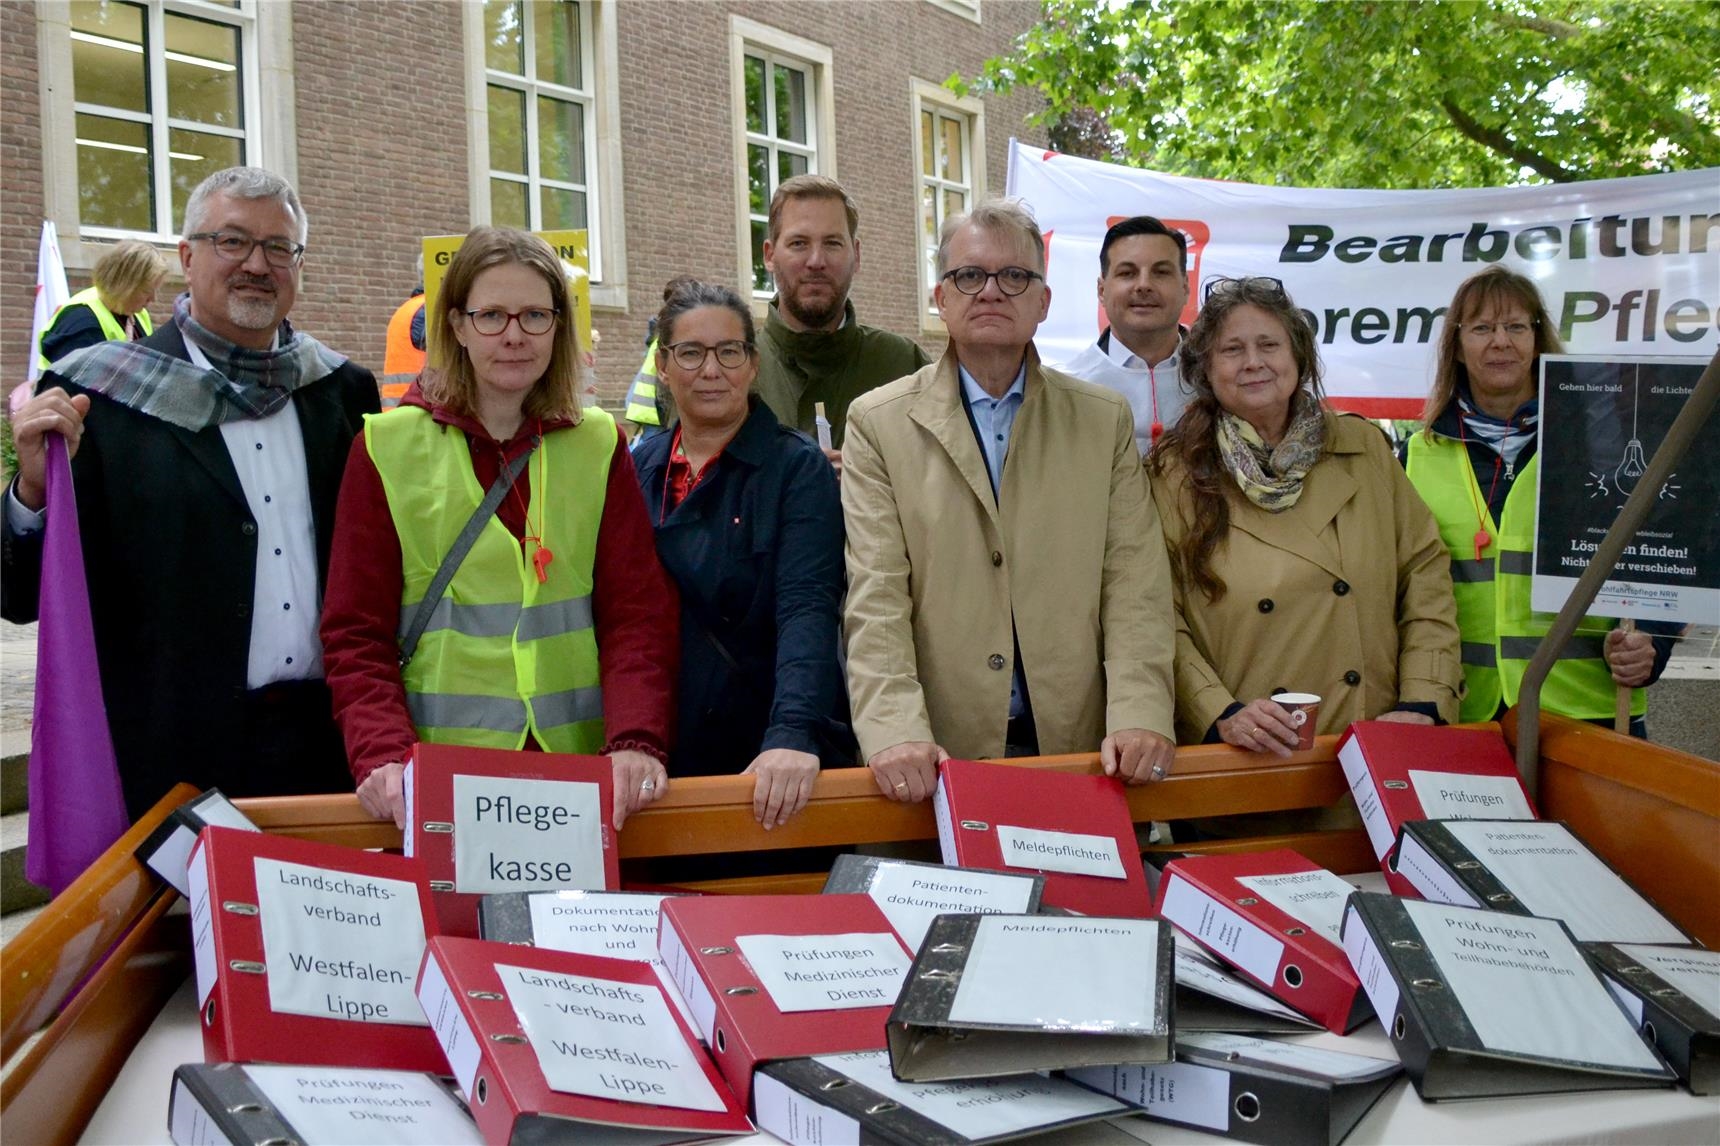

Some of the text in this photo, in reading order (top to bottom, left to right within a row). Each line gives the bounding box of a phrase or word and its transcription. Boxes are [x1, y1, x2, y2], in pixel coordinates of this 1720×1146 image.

[1559, 287, 1720, 343] Pfle
[1558, 383, 1585, 392] Gehen
[1587, 383, 1603, 392] hier
[1604, 384, 1623, 393] bald
[1650, 385, 1664, 394] die
[1640, 544, 1689, 559] finden!
[1628, 563, 1697, 576] verschieben!
[1659, 590, 1679, 598] NRW
[1440, 789, 1504, 807] Prüfungen
[476, 796, 581, 831] Pflege-
[1485, 832, 1547, 841] Patienten-
[1012, 838, 1111, 862] Meldepflichten
[1487, 847, 1578, 856] dokumentation
[490, 852, 572, 882] kasse
[279, 869, 397, 900] Landschafts-
[911, 879, 989, 896] Patienten-
[887, 895, 1002, 914] dokumentation
[303, 904, 382, 927] verband
[569, 923, 608, 933] nach
[1002, 924, 1132, 936] Meldepflichten
[1445, 918, 1537, 940] Prüfungen
[605, 939, 636, 950] und
[1456, 937, 1550, 960] Wohn- und
[782, 949, 875, 962] Prüfungen
[1452, 951, 1576, 977] Teilhabebehörden
[289, 952, 412, 984] Westfalen-
[784, 965, 900, 983] Medizinischer
[518, 971, 645, 1003] Landschafts
[826, 987, 886, 1002] Dienst
[327, 993, 389, 1020] Lippe
[556, 1003, 646, 1027] verband
[552, 1039, 680, 1071] Westfalen-
[296, 1078, 404, 1091] Prüfungen
[600, 1074, 666, 1095] Lippe
[298, 1094, 433, 1108] Medizinischer
[348, 1110, 418, 1124] Dienst
